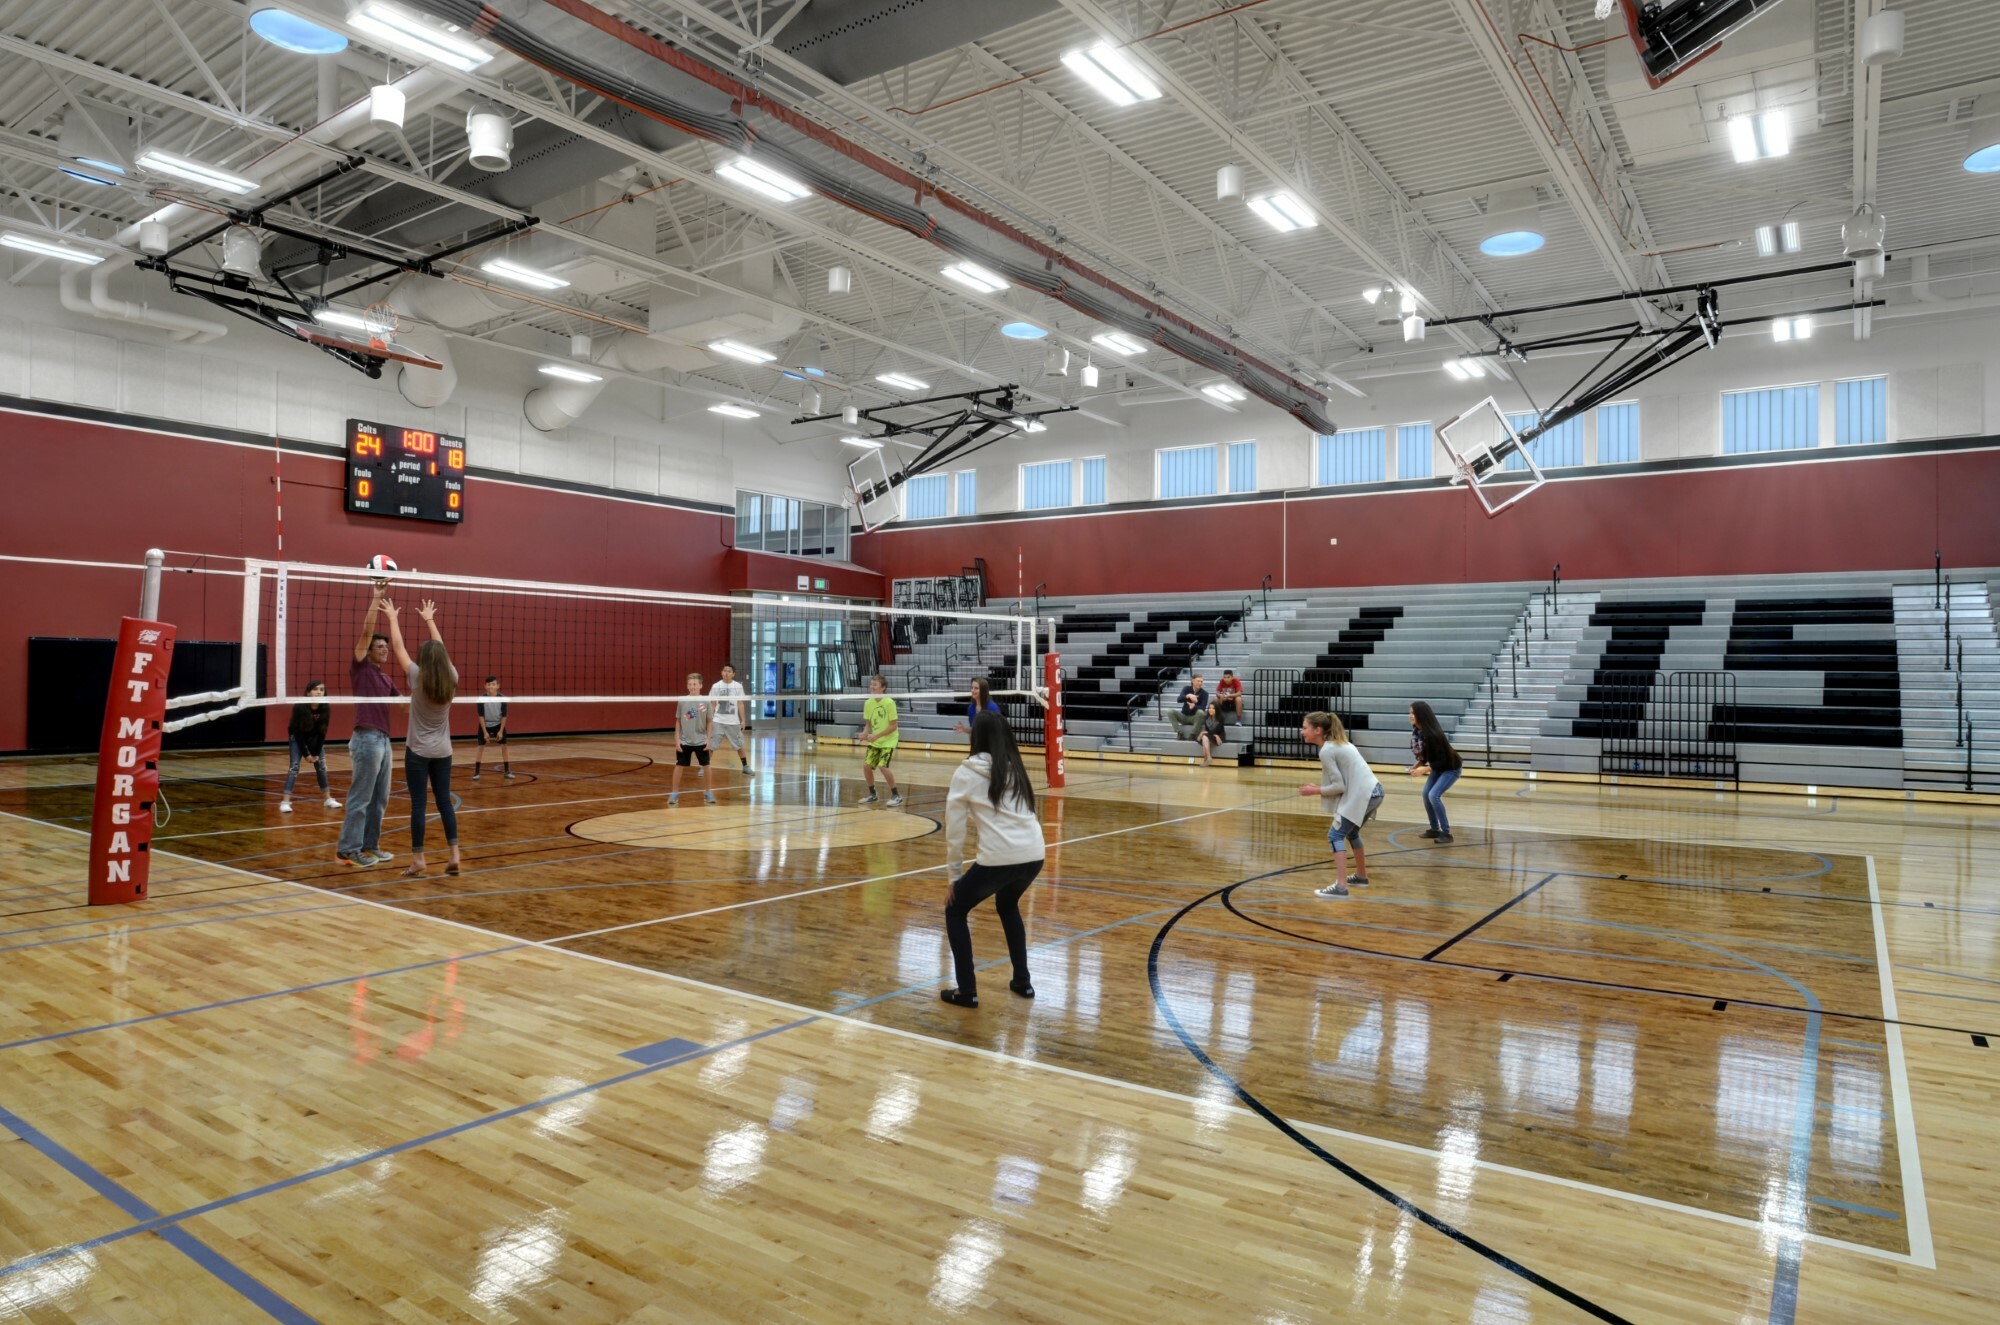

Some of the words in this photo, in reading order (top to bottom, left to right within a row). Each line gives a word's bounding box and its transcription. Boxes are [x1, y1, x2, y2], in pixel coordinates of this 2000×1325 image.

[357, 422, 377, 435] Colts
[356, 433, 381, 456] 24
[403, 430, 434, 454] 1:00
[440, 436, 463, 449] Guests
[399, 460, 421, 472] period
[448, 449, 463, 470] 18
[398, 472, 421, 485] player
[359, 480, 369, 496] 0
[355, 500, 370, 509] won
[449, 492, 459, 508] 0
[400, 505, 418, 514] game
[446, 510, 459, 519] won
[127, 651, 153, 703] FT
[1055, 668, 1064, 775] COLTS
[106, 716, 145, 883] MORGAN
